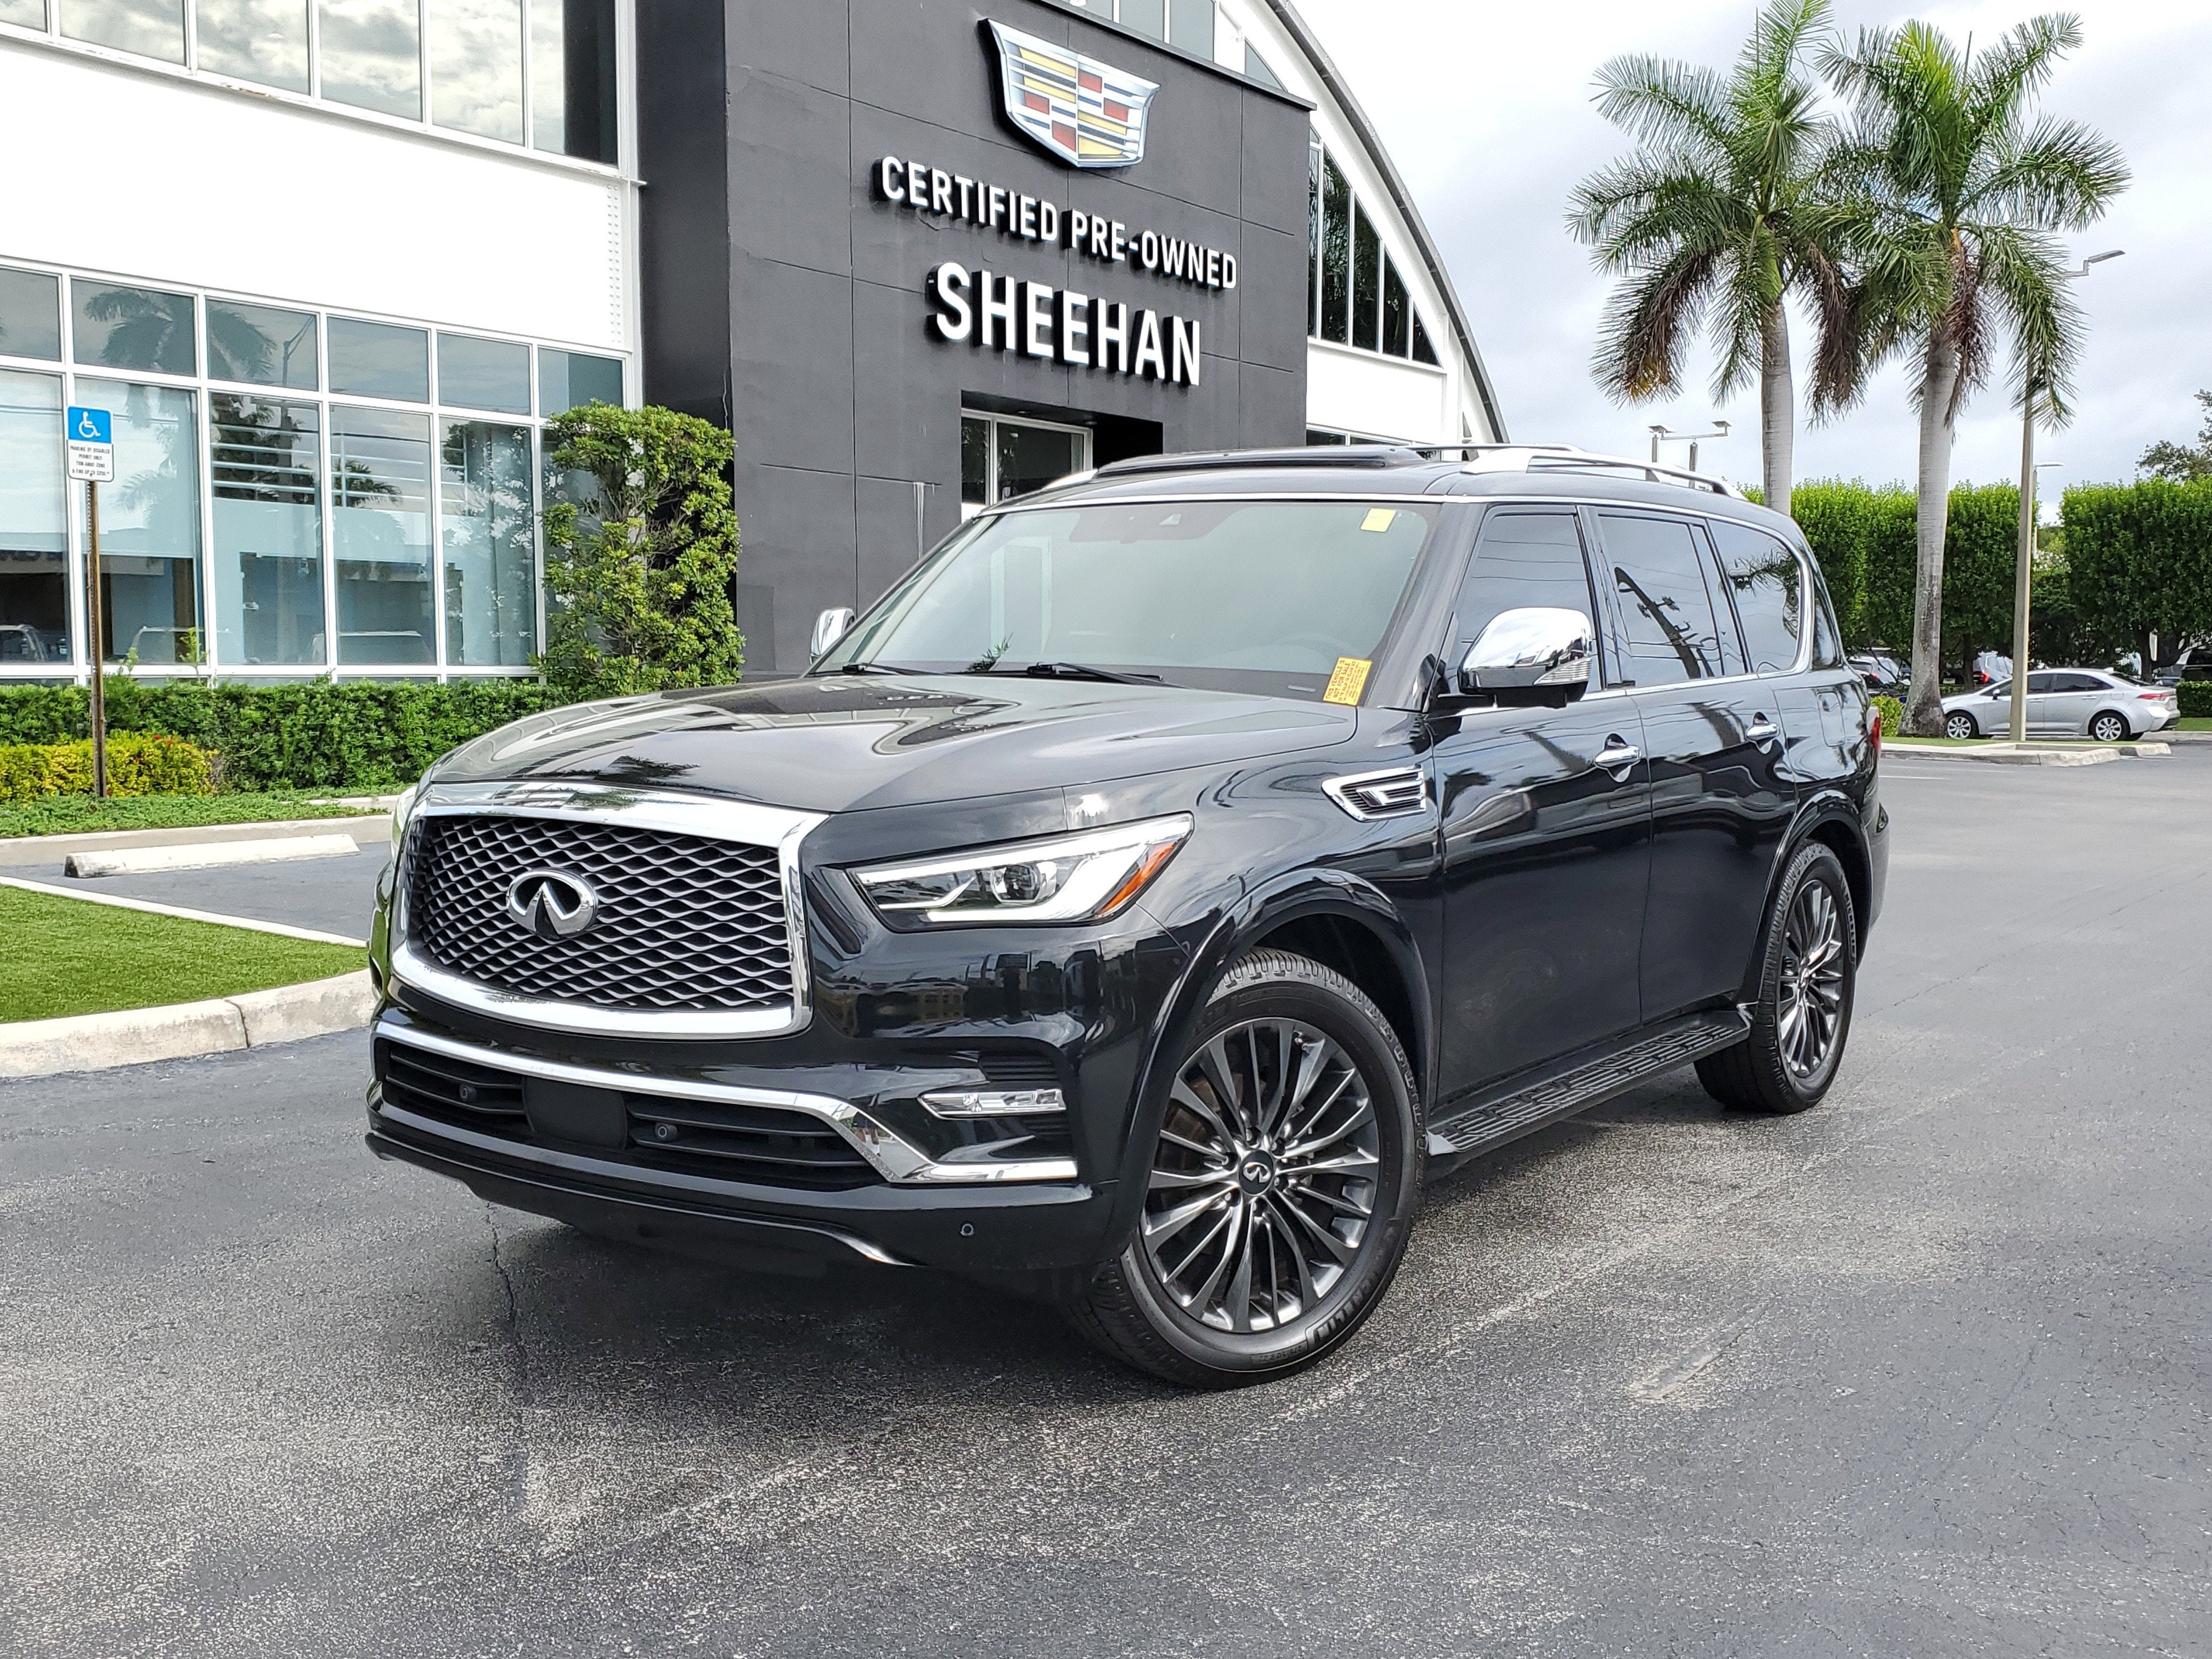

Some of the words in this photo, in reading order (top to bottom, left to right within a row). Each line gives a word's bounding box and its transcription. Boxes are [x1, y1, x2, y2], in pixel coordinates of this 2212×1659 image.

[881, 155, 1058, 242] CERTIFIED
[1071, 208, 1237, 290] PRE-OWNED
[935, 261, 1200, 386] SHEEHAN
[1325, 687, 1334, 699] THIS
[1331, 666, 1342, 686] VEHICLE
[1333, 687, 1341, 698] NOT
[1337, 676, 1345, 687] FOR
[1341, 663, 1351, 675] SALE
